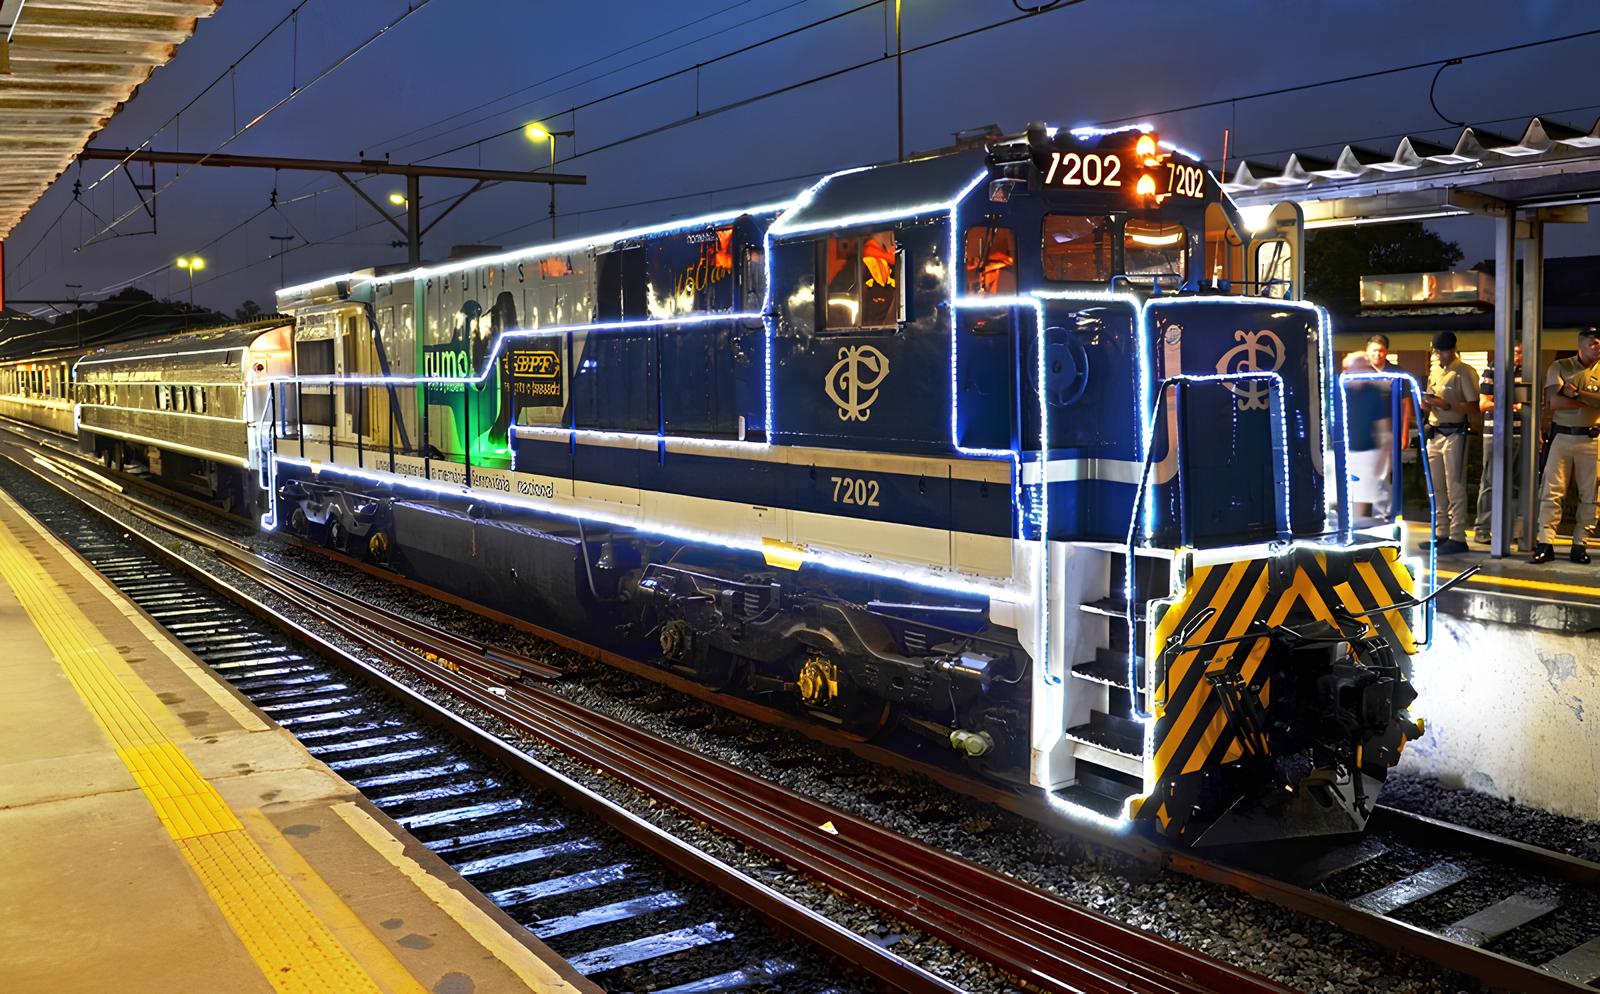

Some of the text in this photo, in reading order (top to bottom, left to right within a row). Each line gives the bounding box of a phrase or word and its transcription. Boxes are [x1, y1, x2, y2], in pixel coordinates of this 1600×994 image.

[1045, 152, 1121, 187] 7202
[1166, 163, 1204, 198] 7202
[424, 350, 468, 378] rumo
[831, 476, 880, 507] 7202
